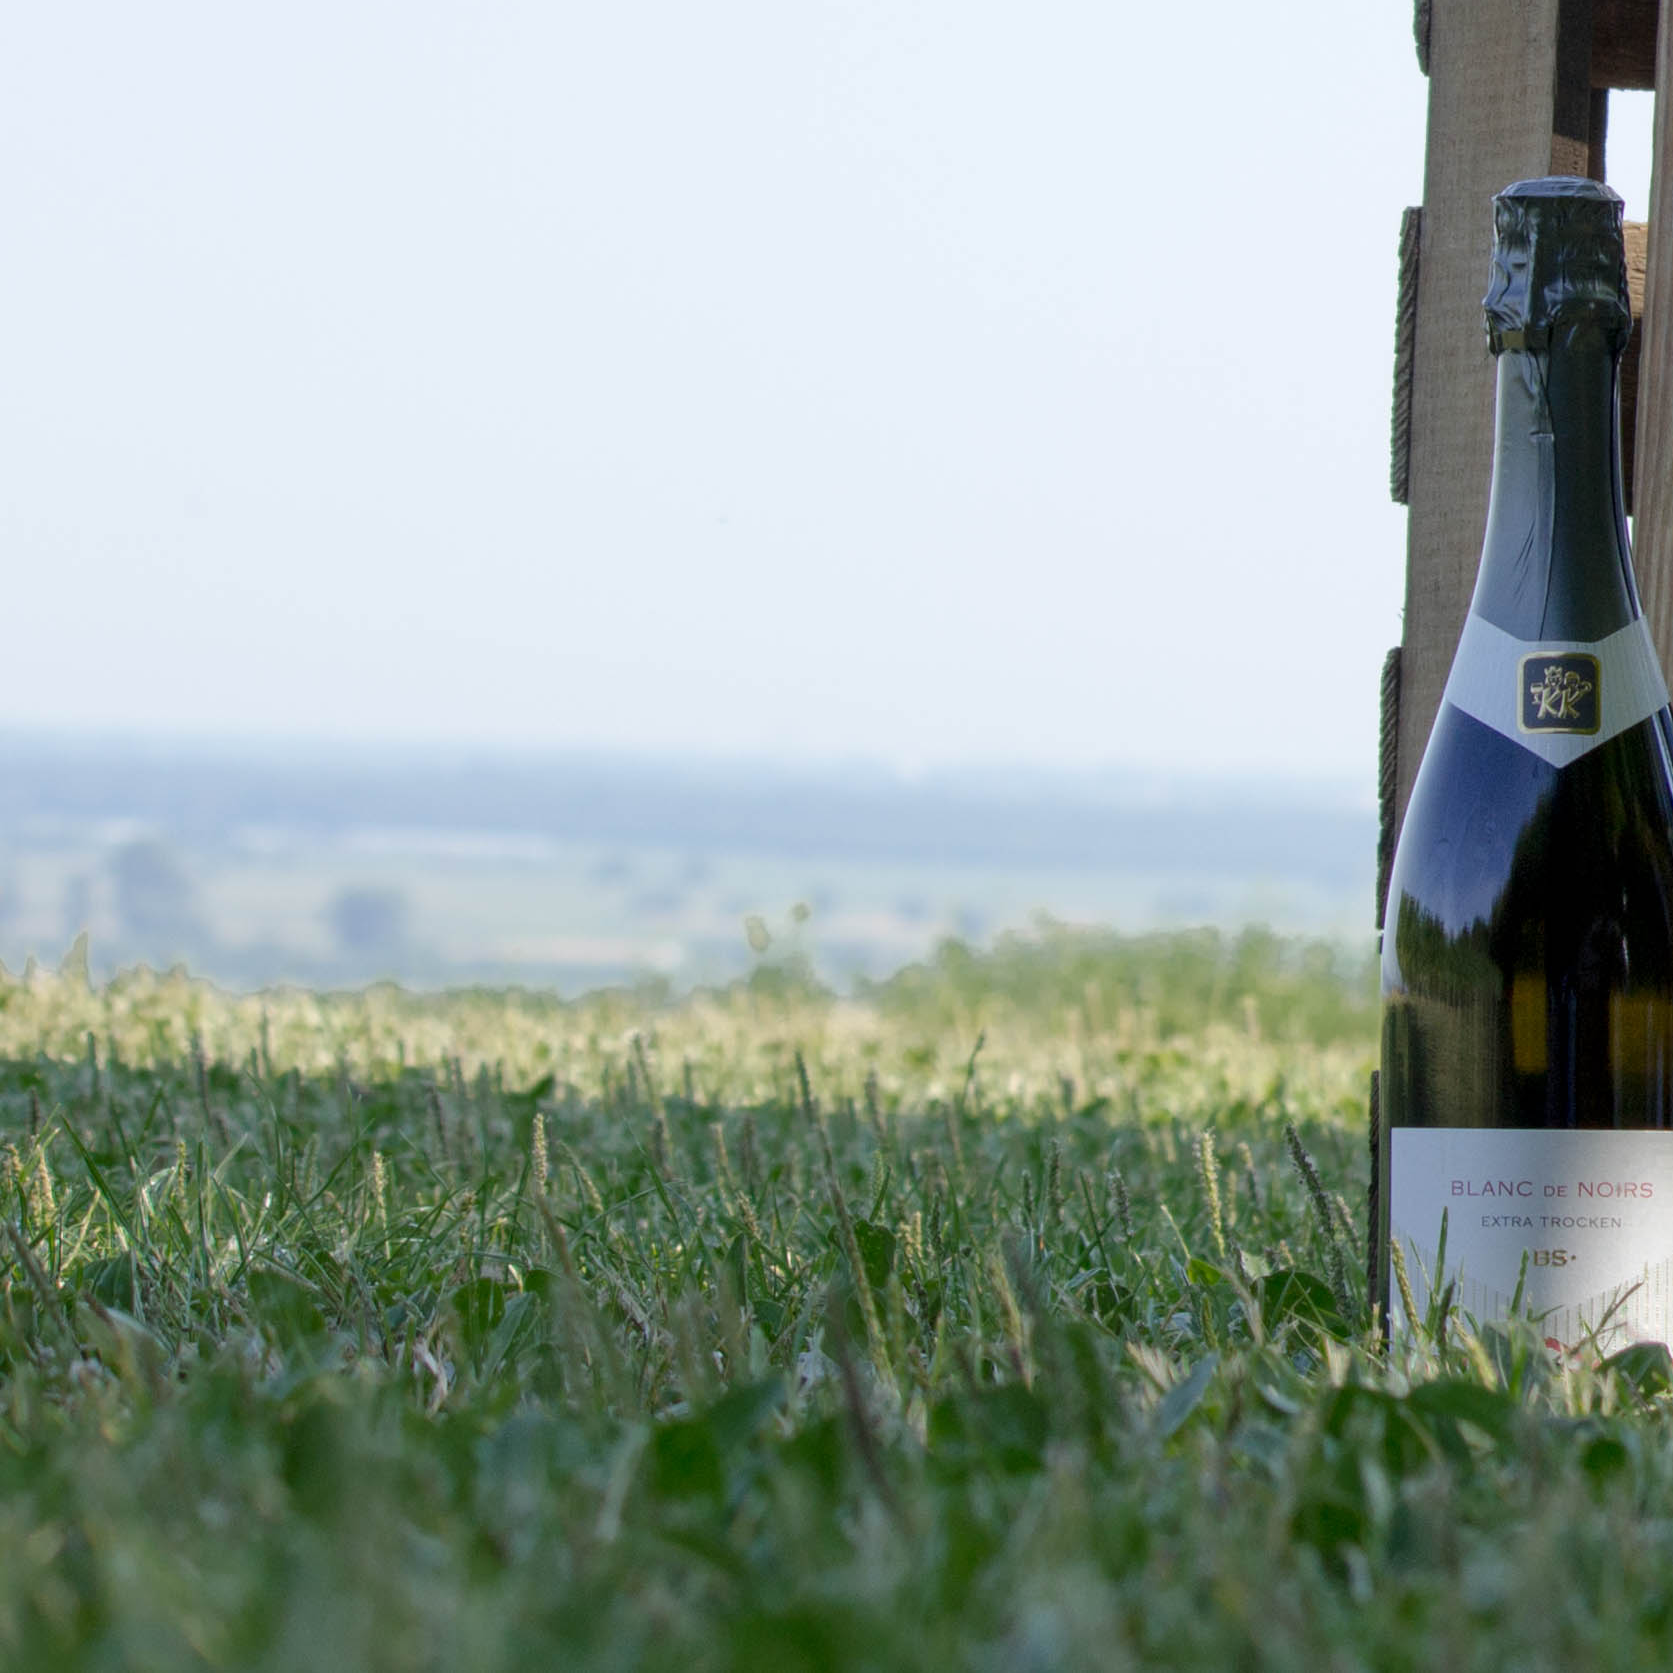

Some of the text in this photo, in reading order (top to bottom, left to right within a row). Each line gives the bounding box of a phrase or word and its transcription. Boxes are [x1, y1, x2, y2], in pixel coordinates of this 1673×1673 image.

[1450, 1180, 1654, 1199] BLANC DE NOIRS
[1481, 1215, 1622, 1229] EXTRA TROCKEN
